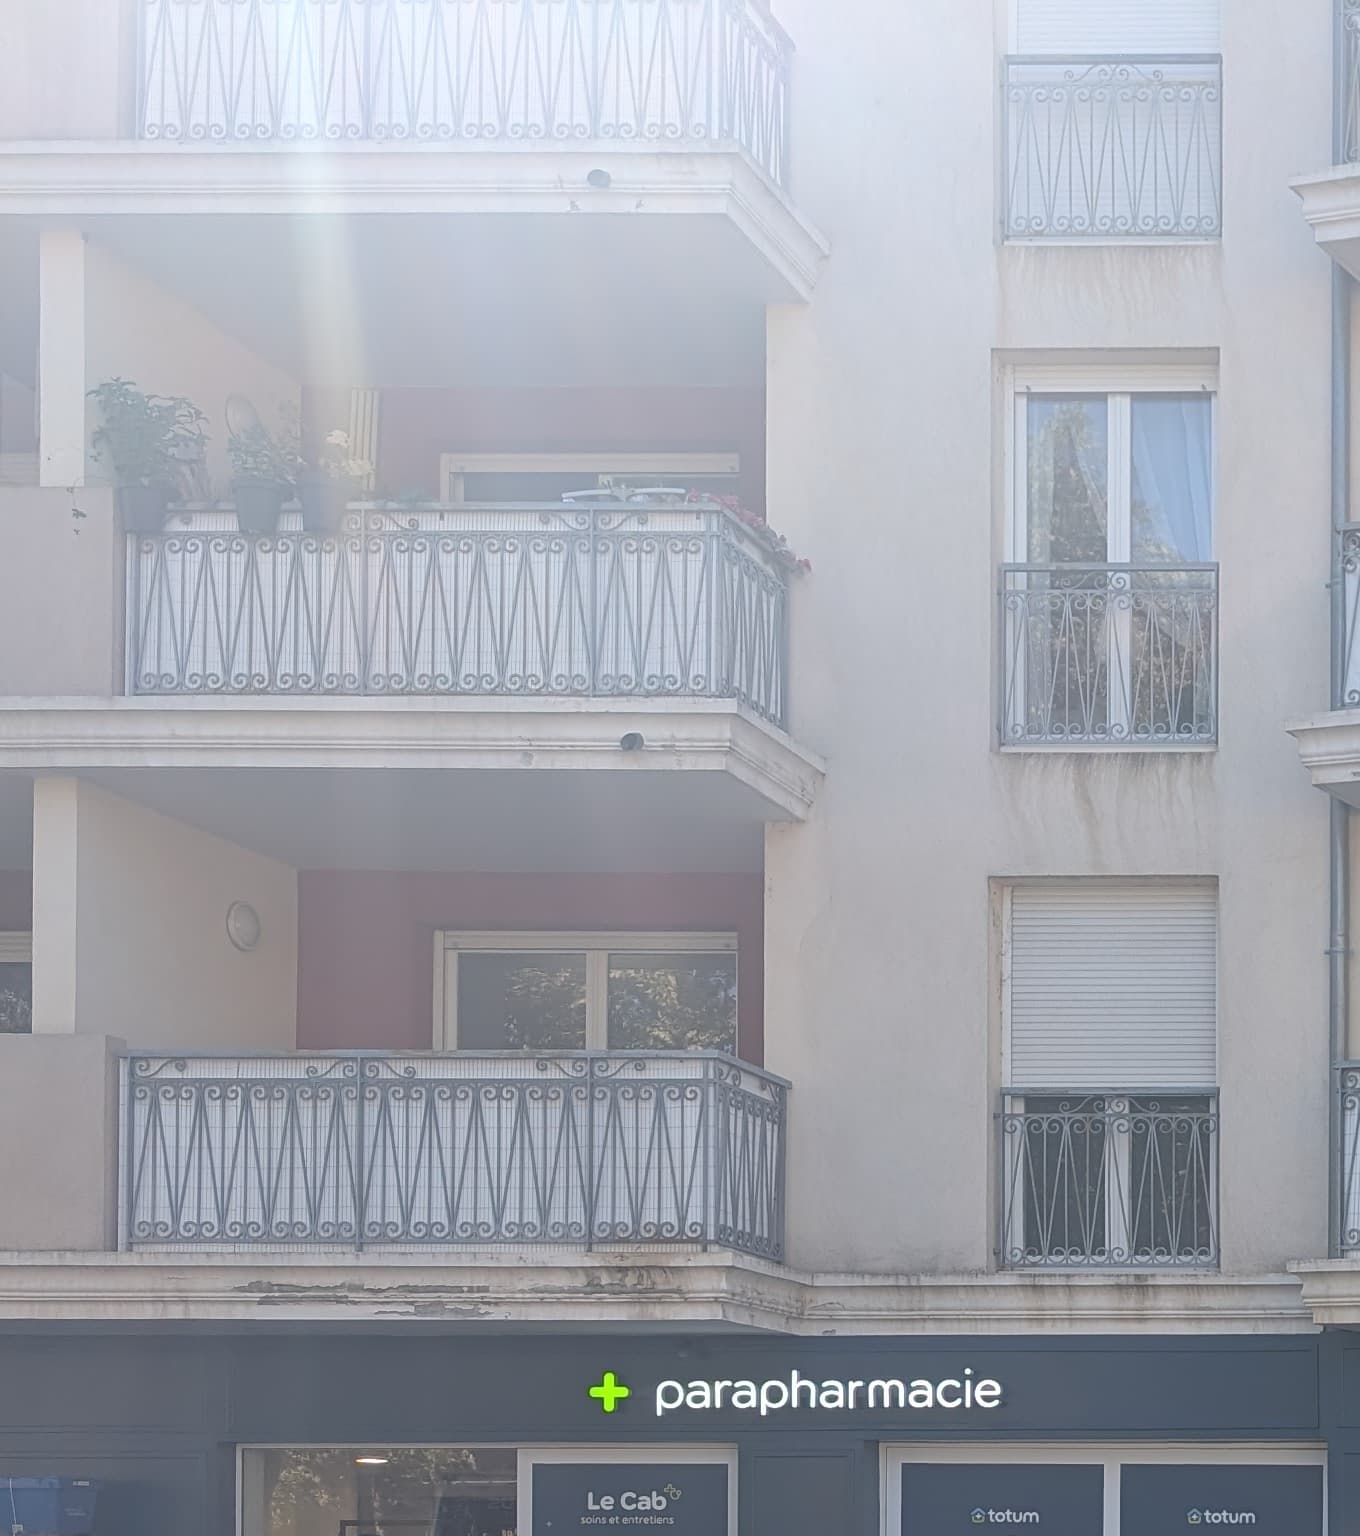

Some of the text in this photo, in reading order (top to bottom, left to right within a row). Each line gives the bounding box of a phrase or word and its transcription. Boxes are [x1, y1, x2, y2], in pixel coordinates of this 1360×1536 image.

[655, 1369, 1002, 1416] parapharmacie
[587, 1491, 667, 1511] Le Cab
[580, 1515, 674, 1525] soins et entretiens
[987, 1508, 1040, 1523] totum
[1203, 1508, 1256, 1524] totum
